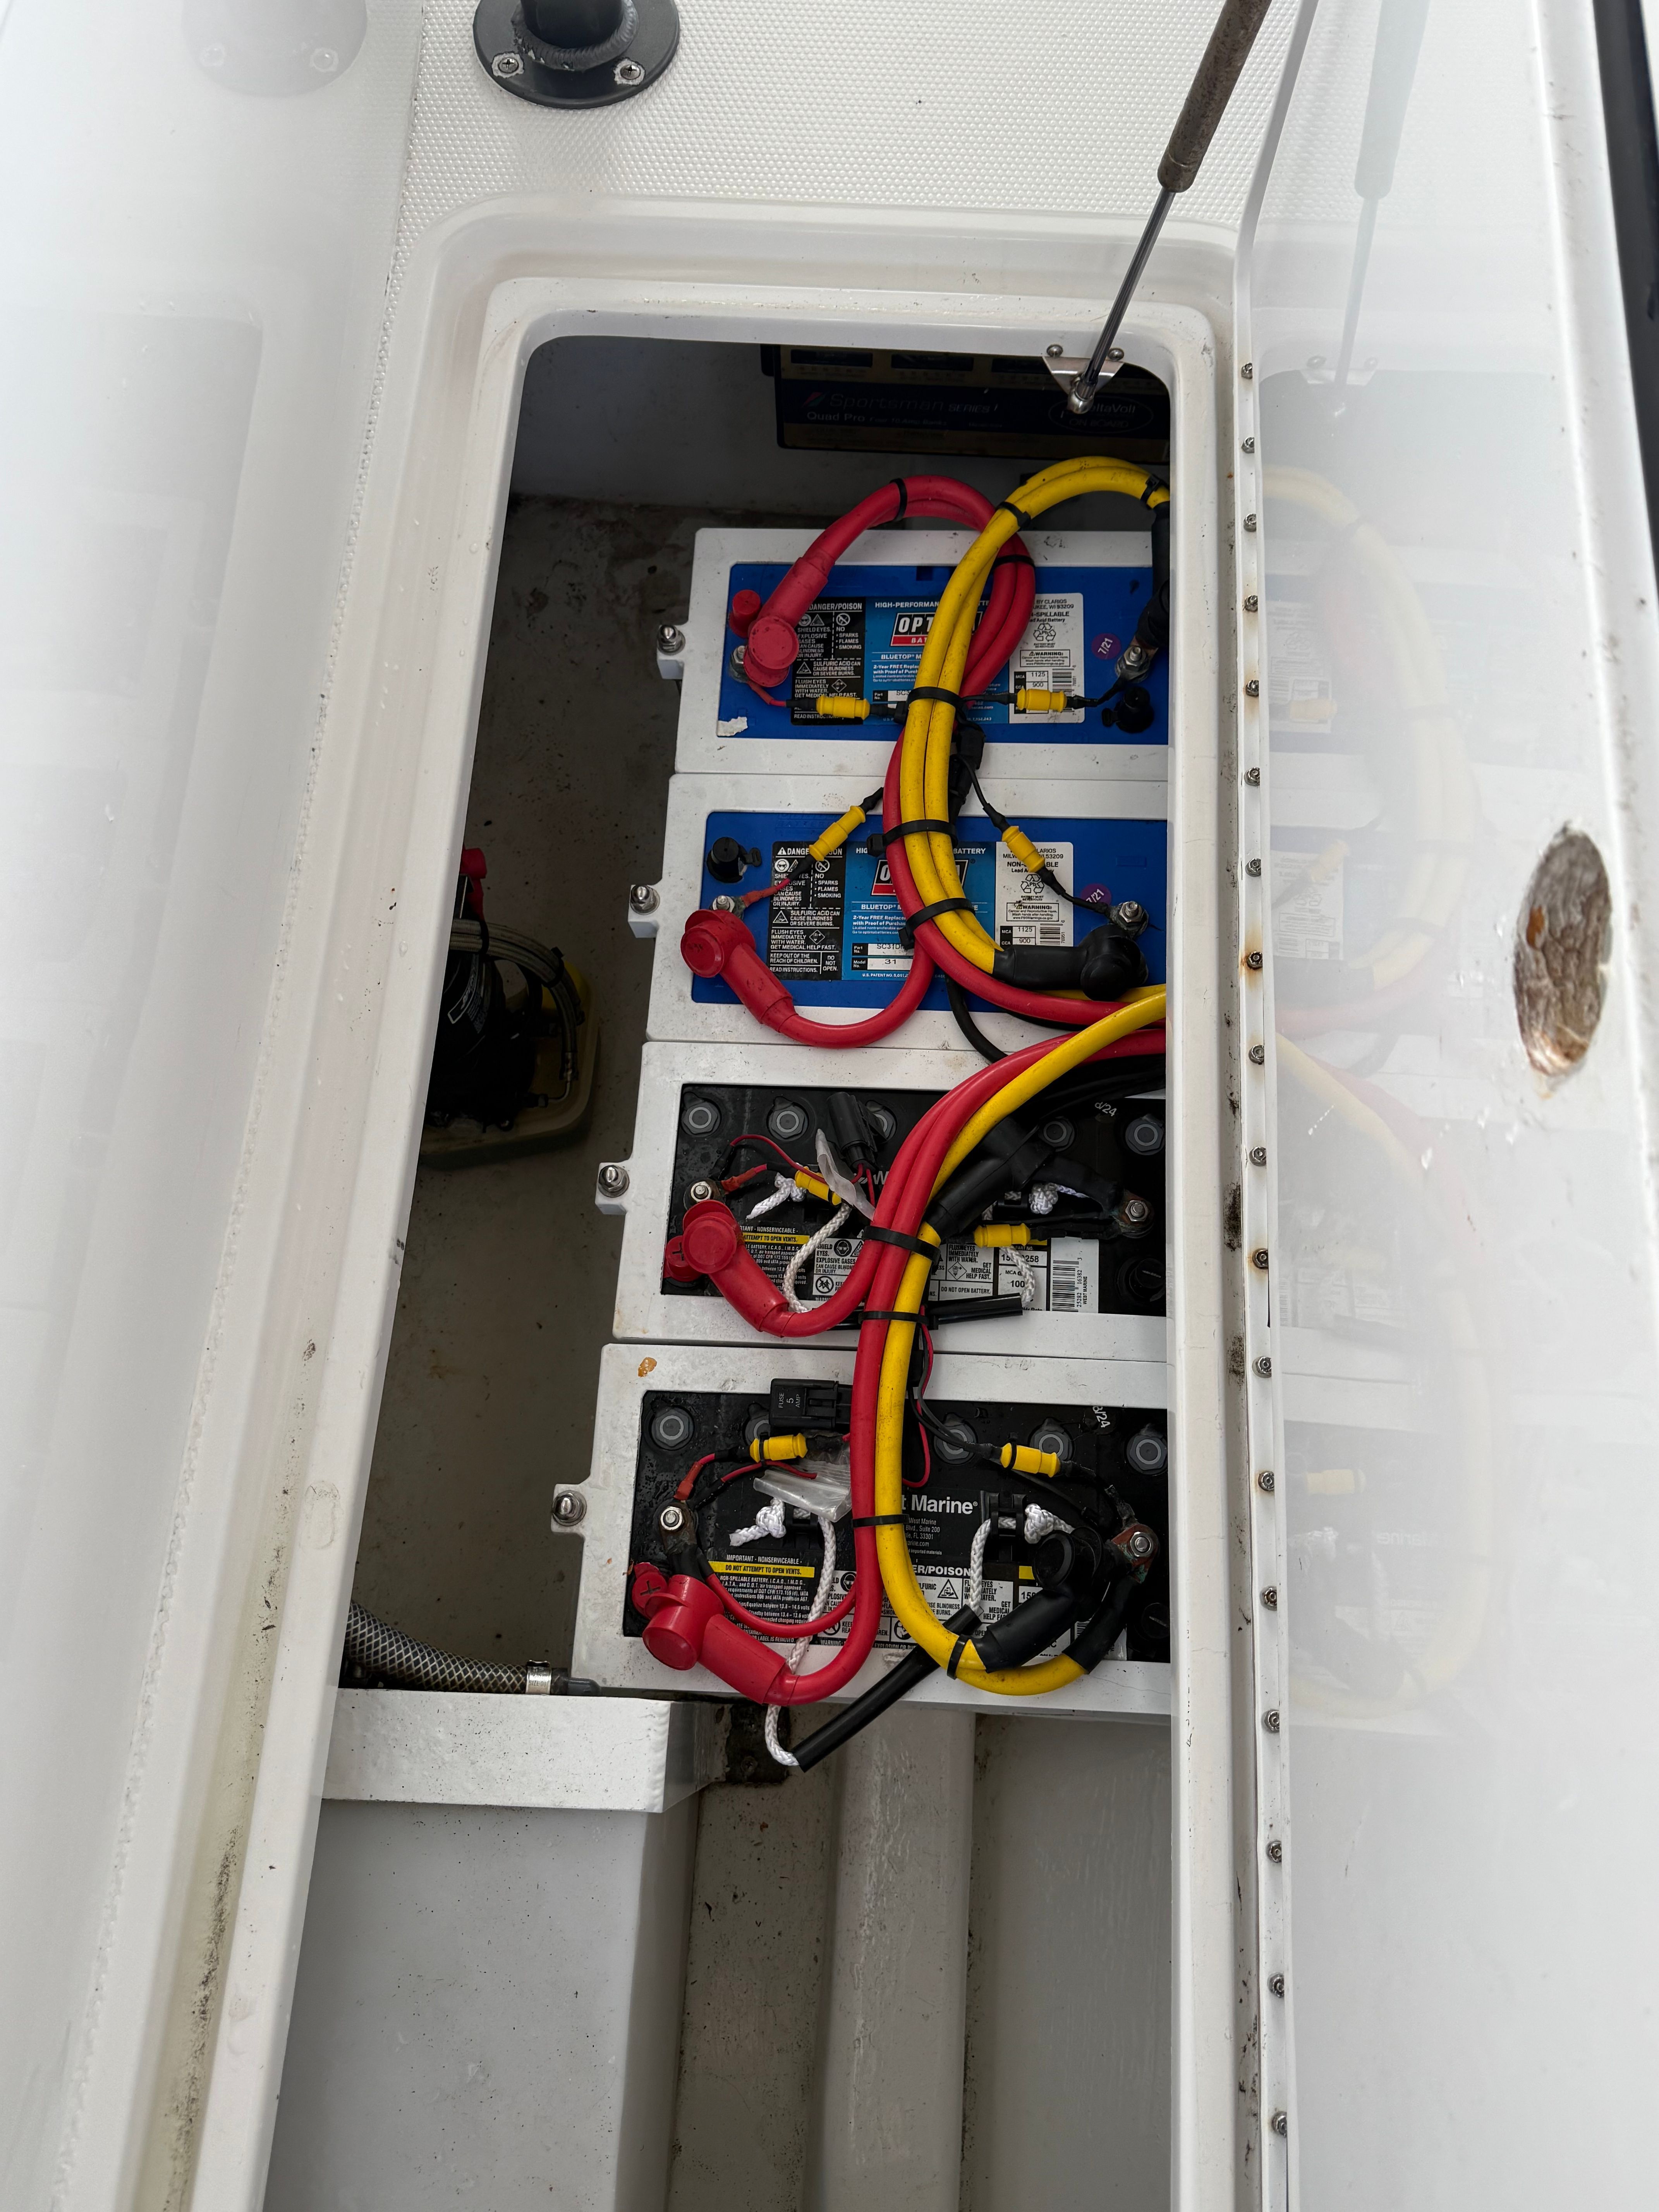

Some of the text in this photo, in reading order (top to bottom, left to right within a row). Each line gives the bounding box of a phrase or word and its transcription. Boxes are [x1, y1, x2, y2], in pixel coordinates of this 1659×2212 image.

[830, 393, 944, 410] Sportsman
[1089, 403, 1136, 414] eltaVolt
[807, 411, 839, 421] Quad
[844, 413, 865, 422] Pro
[1098, 638, 1113, 654] 7/21
[758, 1556, 799, 1564] NONSERVICEABLE
[914, 1565, 971, 1576] ER/POISON
